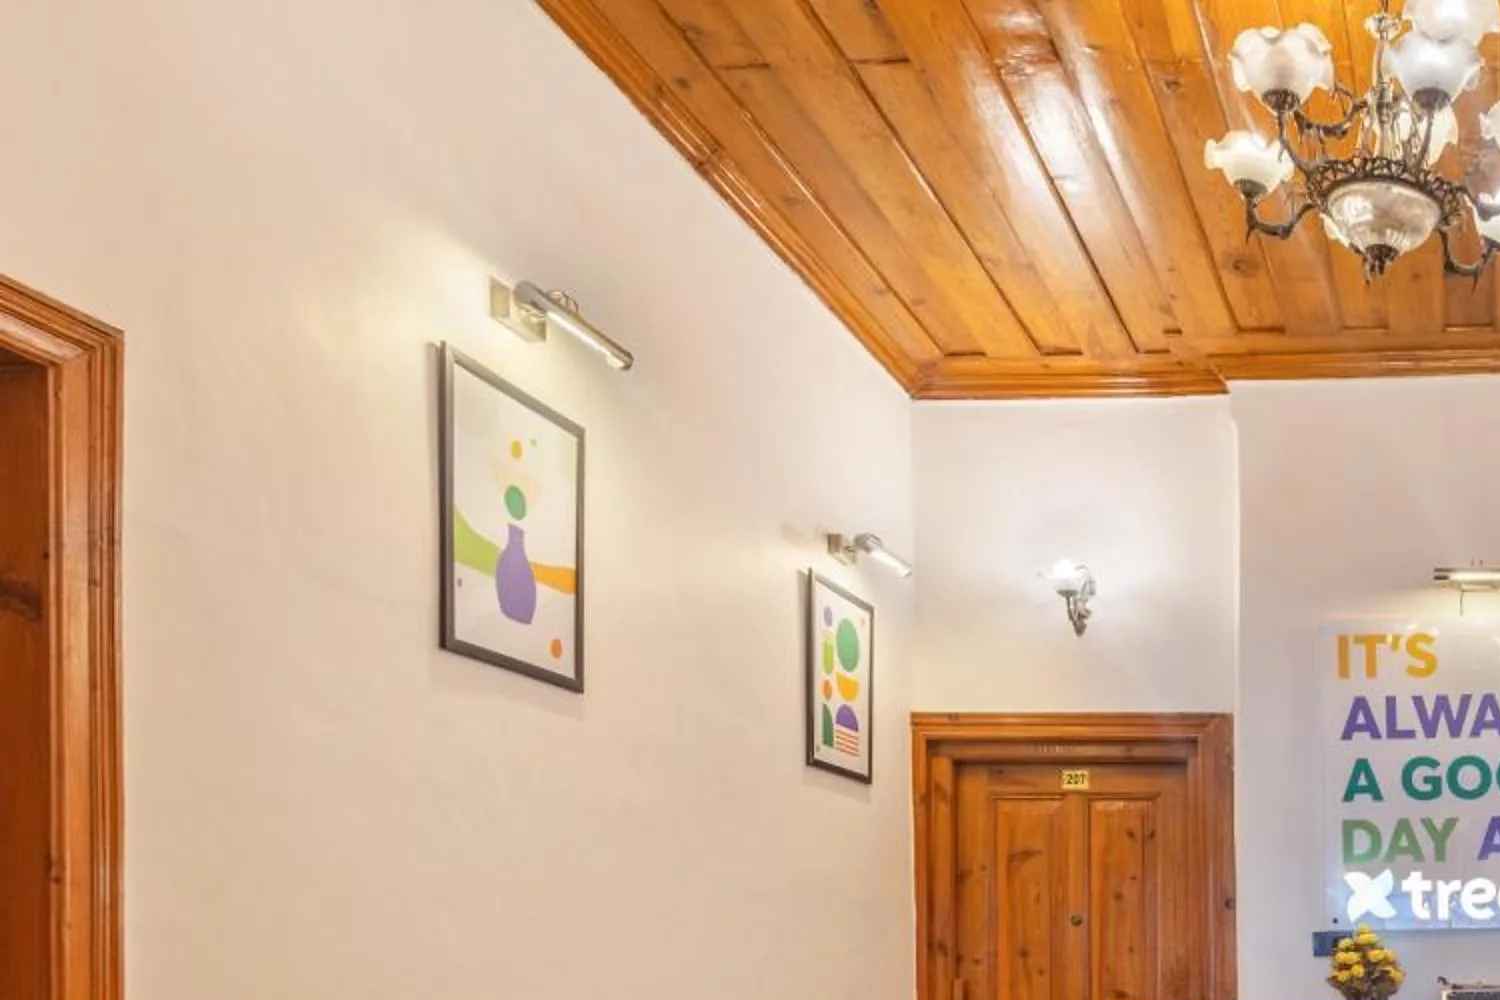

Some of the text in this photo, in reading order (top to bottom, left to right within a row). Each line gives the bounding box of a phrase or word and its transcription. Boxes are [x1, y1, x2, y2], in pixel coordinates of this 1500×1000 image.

[1337, 632, 1438, 680] IT'S
[1342, 757, 1385, 803] A
[1341, 817, 1460, 865] DAY
